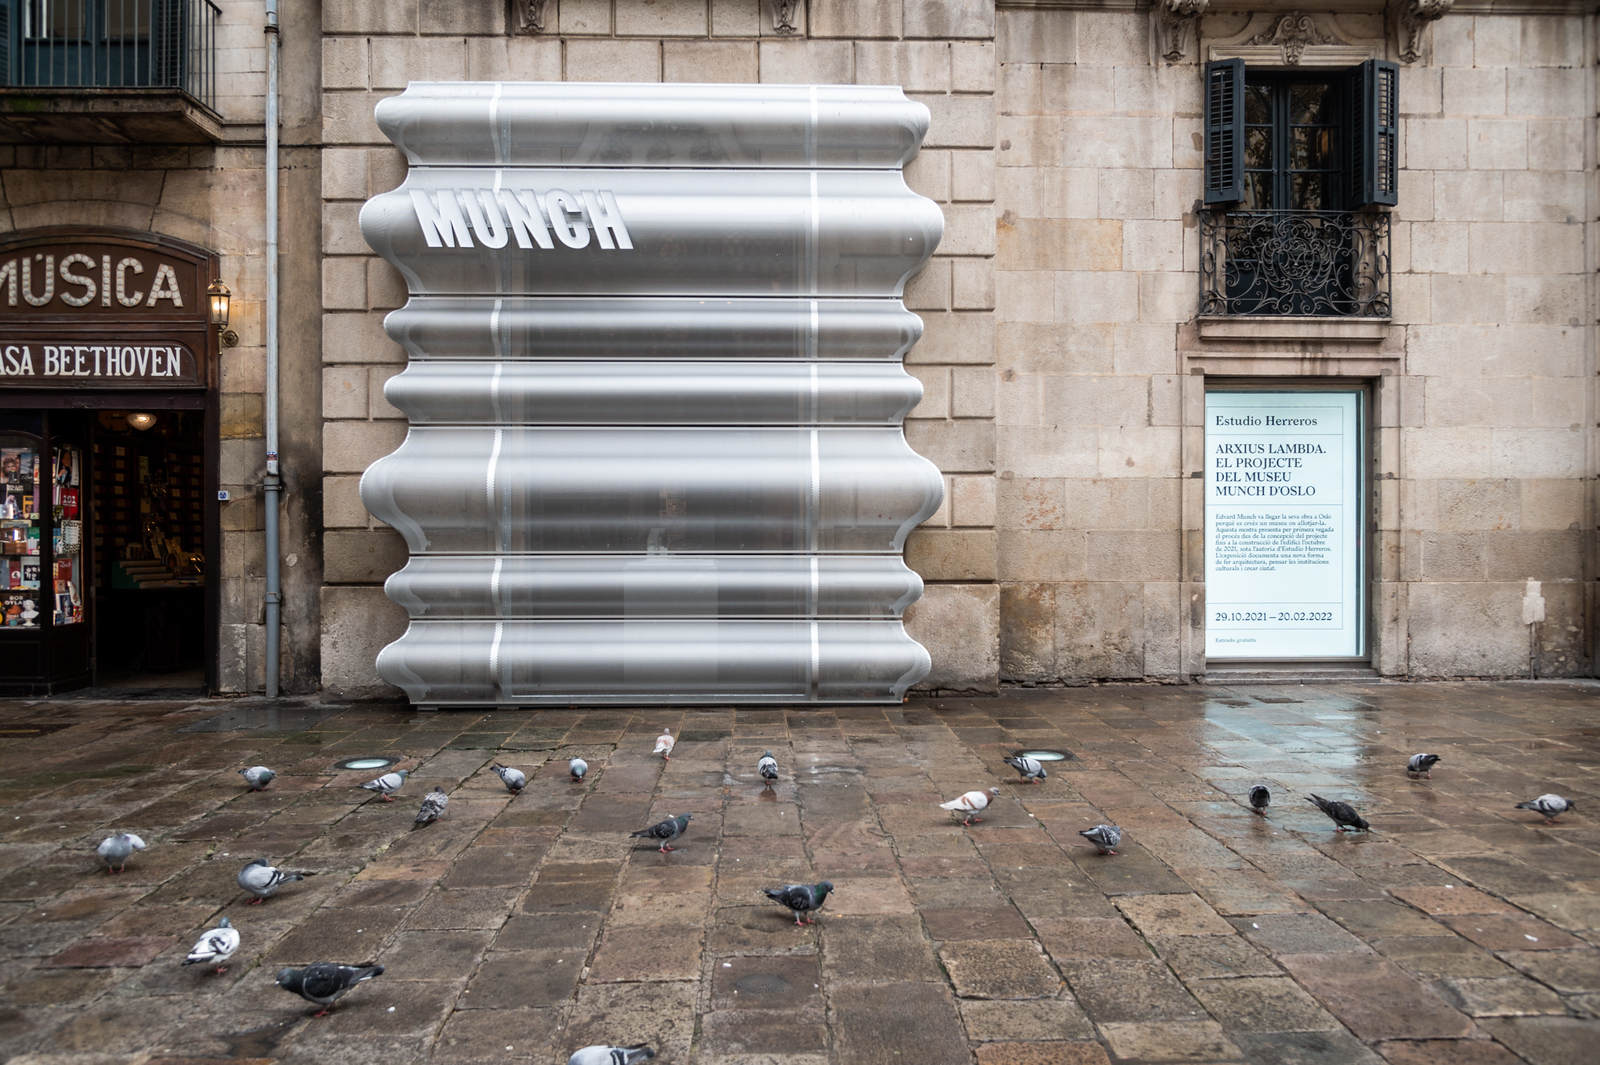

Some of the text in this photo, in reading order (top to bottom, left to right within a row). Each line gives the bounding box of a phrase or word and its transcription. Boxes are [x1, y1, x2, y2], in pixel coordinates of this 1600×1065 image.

[407, 187, 634, 250] MUNCH
[0, 345, 182, 377] SA BEETHOVEN
[1215, 415, 1318, 426] Estudio Herreros
[1215, 443, 1327, 454] ARXIUS LAMBDA.
[1215, 457, 1303, 469] EL PROJECTE
[1215, 471, 1292, 482] DEL MUSEU
[1215, 485, 1316, 496] MUNCH D'OSLO
[1215, 612, 1267, 621] 29.10.2021
[1278, 612, 1333, 621] 20.02.2022
